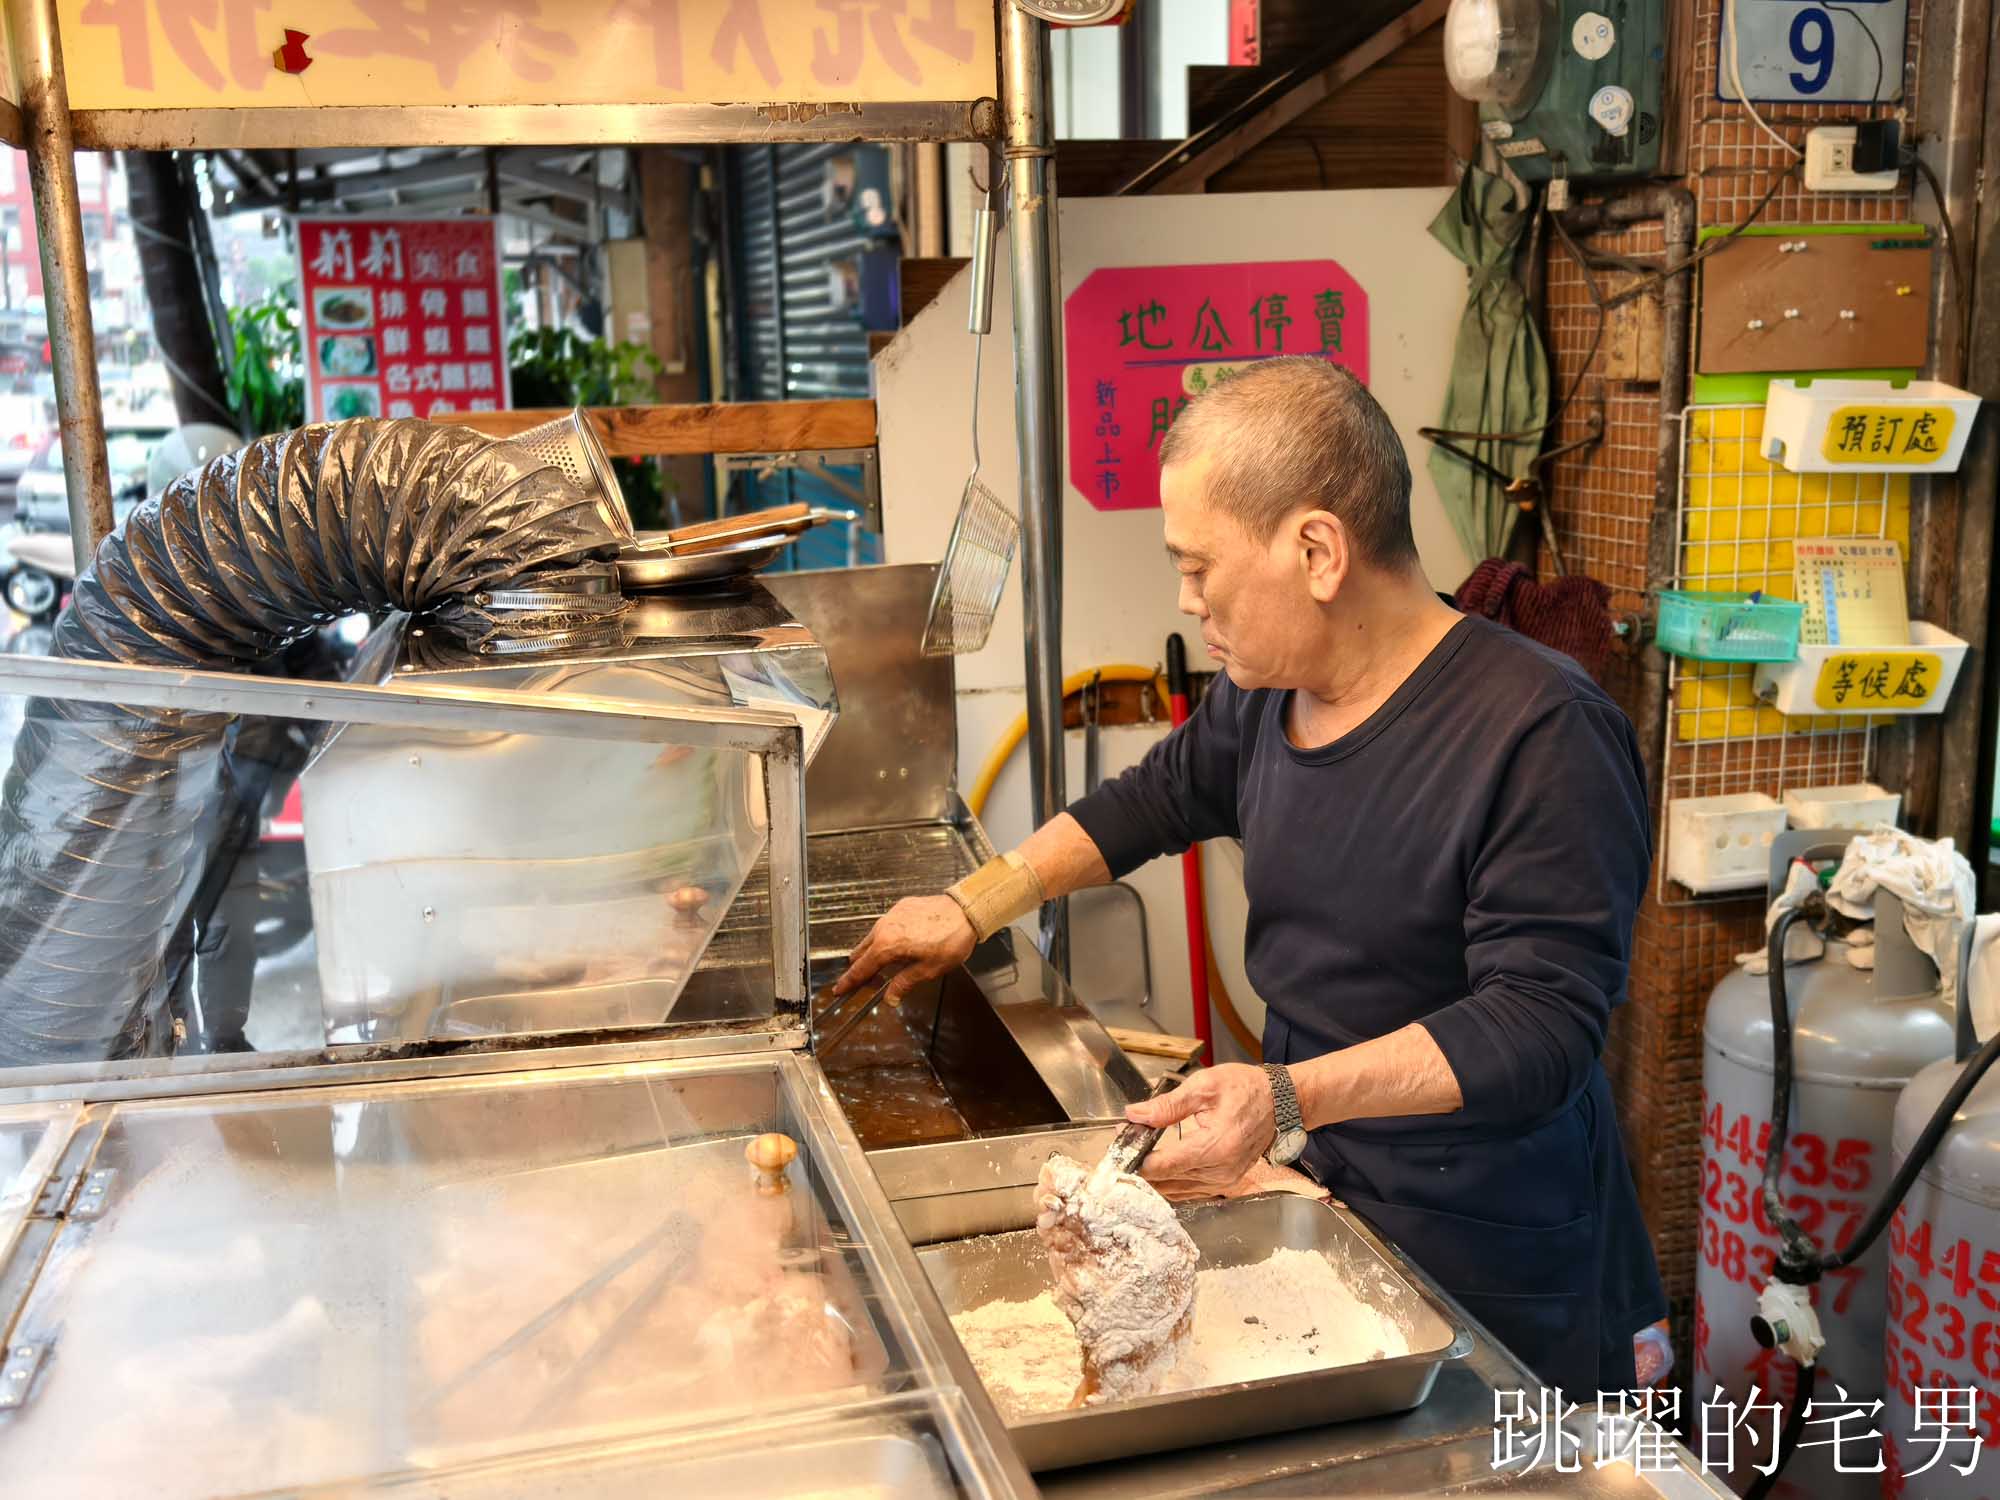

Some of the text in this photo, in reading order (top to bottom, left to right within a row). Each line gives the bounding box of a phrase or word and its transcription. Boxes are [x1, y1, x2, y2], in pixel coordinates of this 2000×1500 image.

[1789, 7, 1835, 94] 9
[310, 228, 404, 281] 莉莉
[1095, 379, 1121, 500] 新品上市
[1838, 411, 1938, 454] 預訂處
[1832, 658, 1927, 704] 等候處
